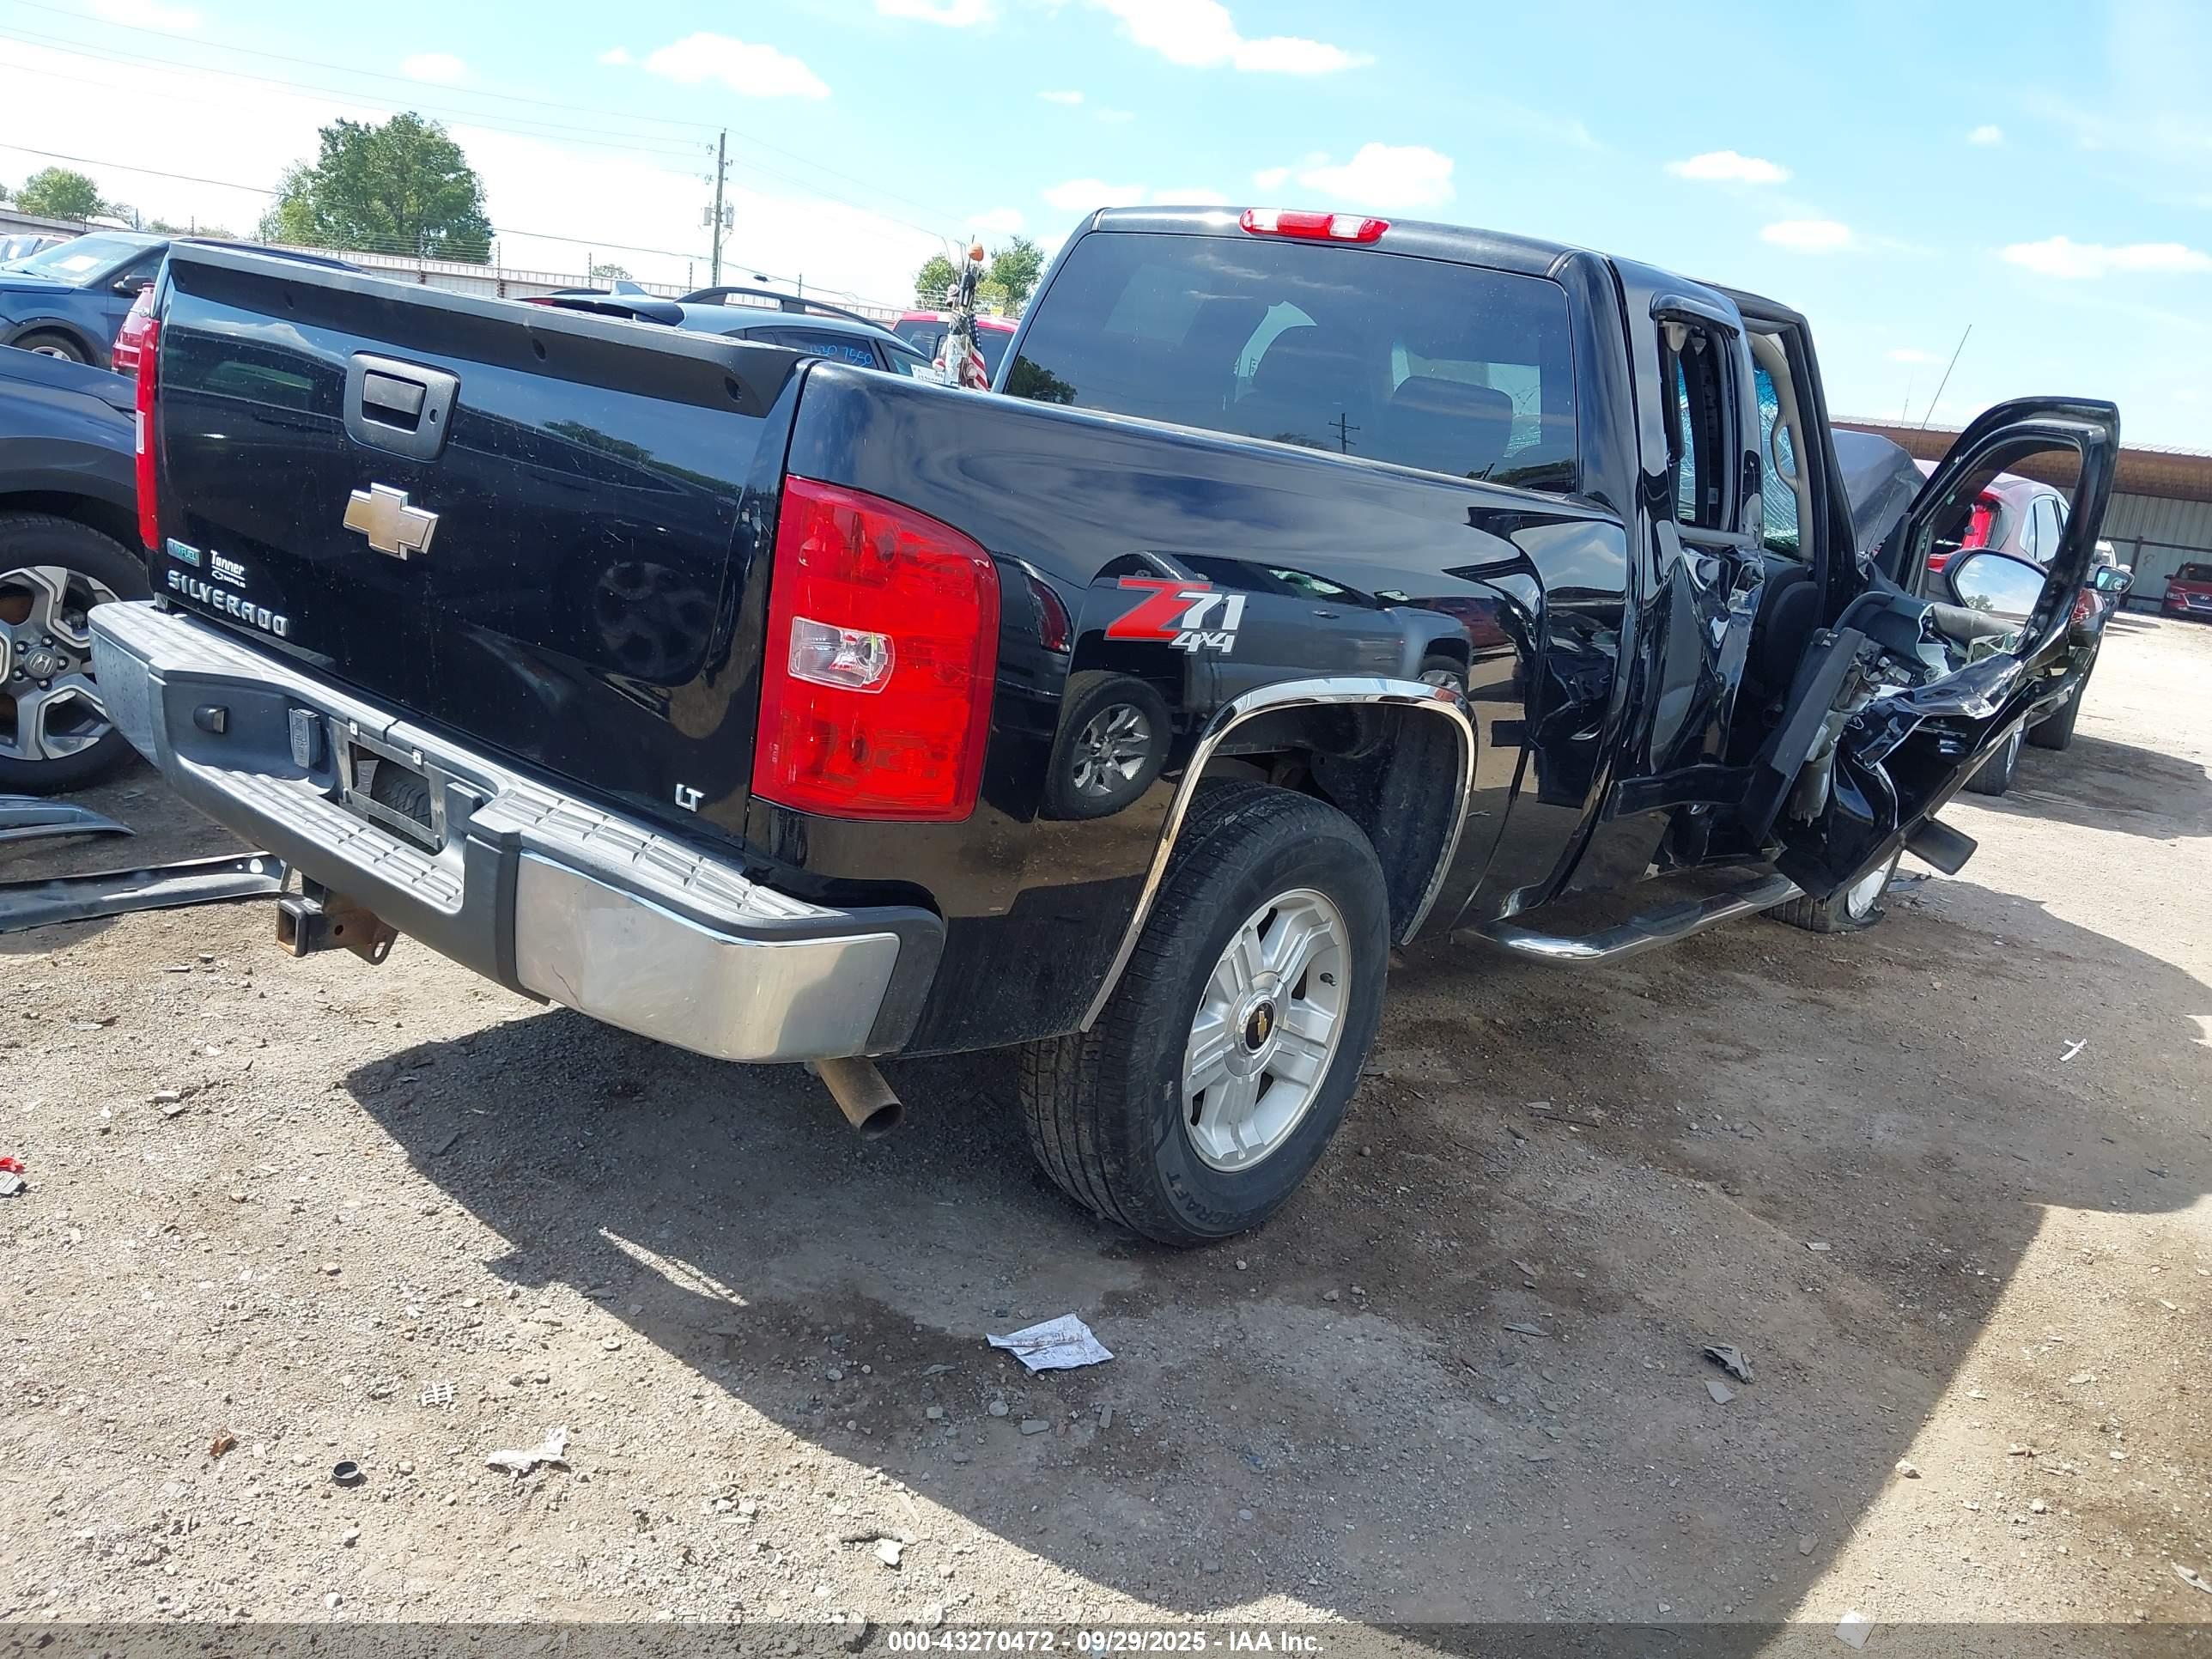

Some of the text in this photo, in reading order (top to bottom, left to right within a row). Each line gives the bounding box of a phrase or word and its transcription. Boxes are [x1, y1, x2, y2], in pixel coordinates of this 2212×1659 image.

[210, 550, 245, 575] Tanner
[167, 569, 289, 637] SILVERADO
[1104, 576, 1248, 640] Z71
[675, 783, 706, 812] LT
